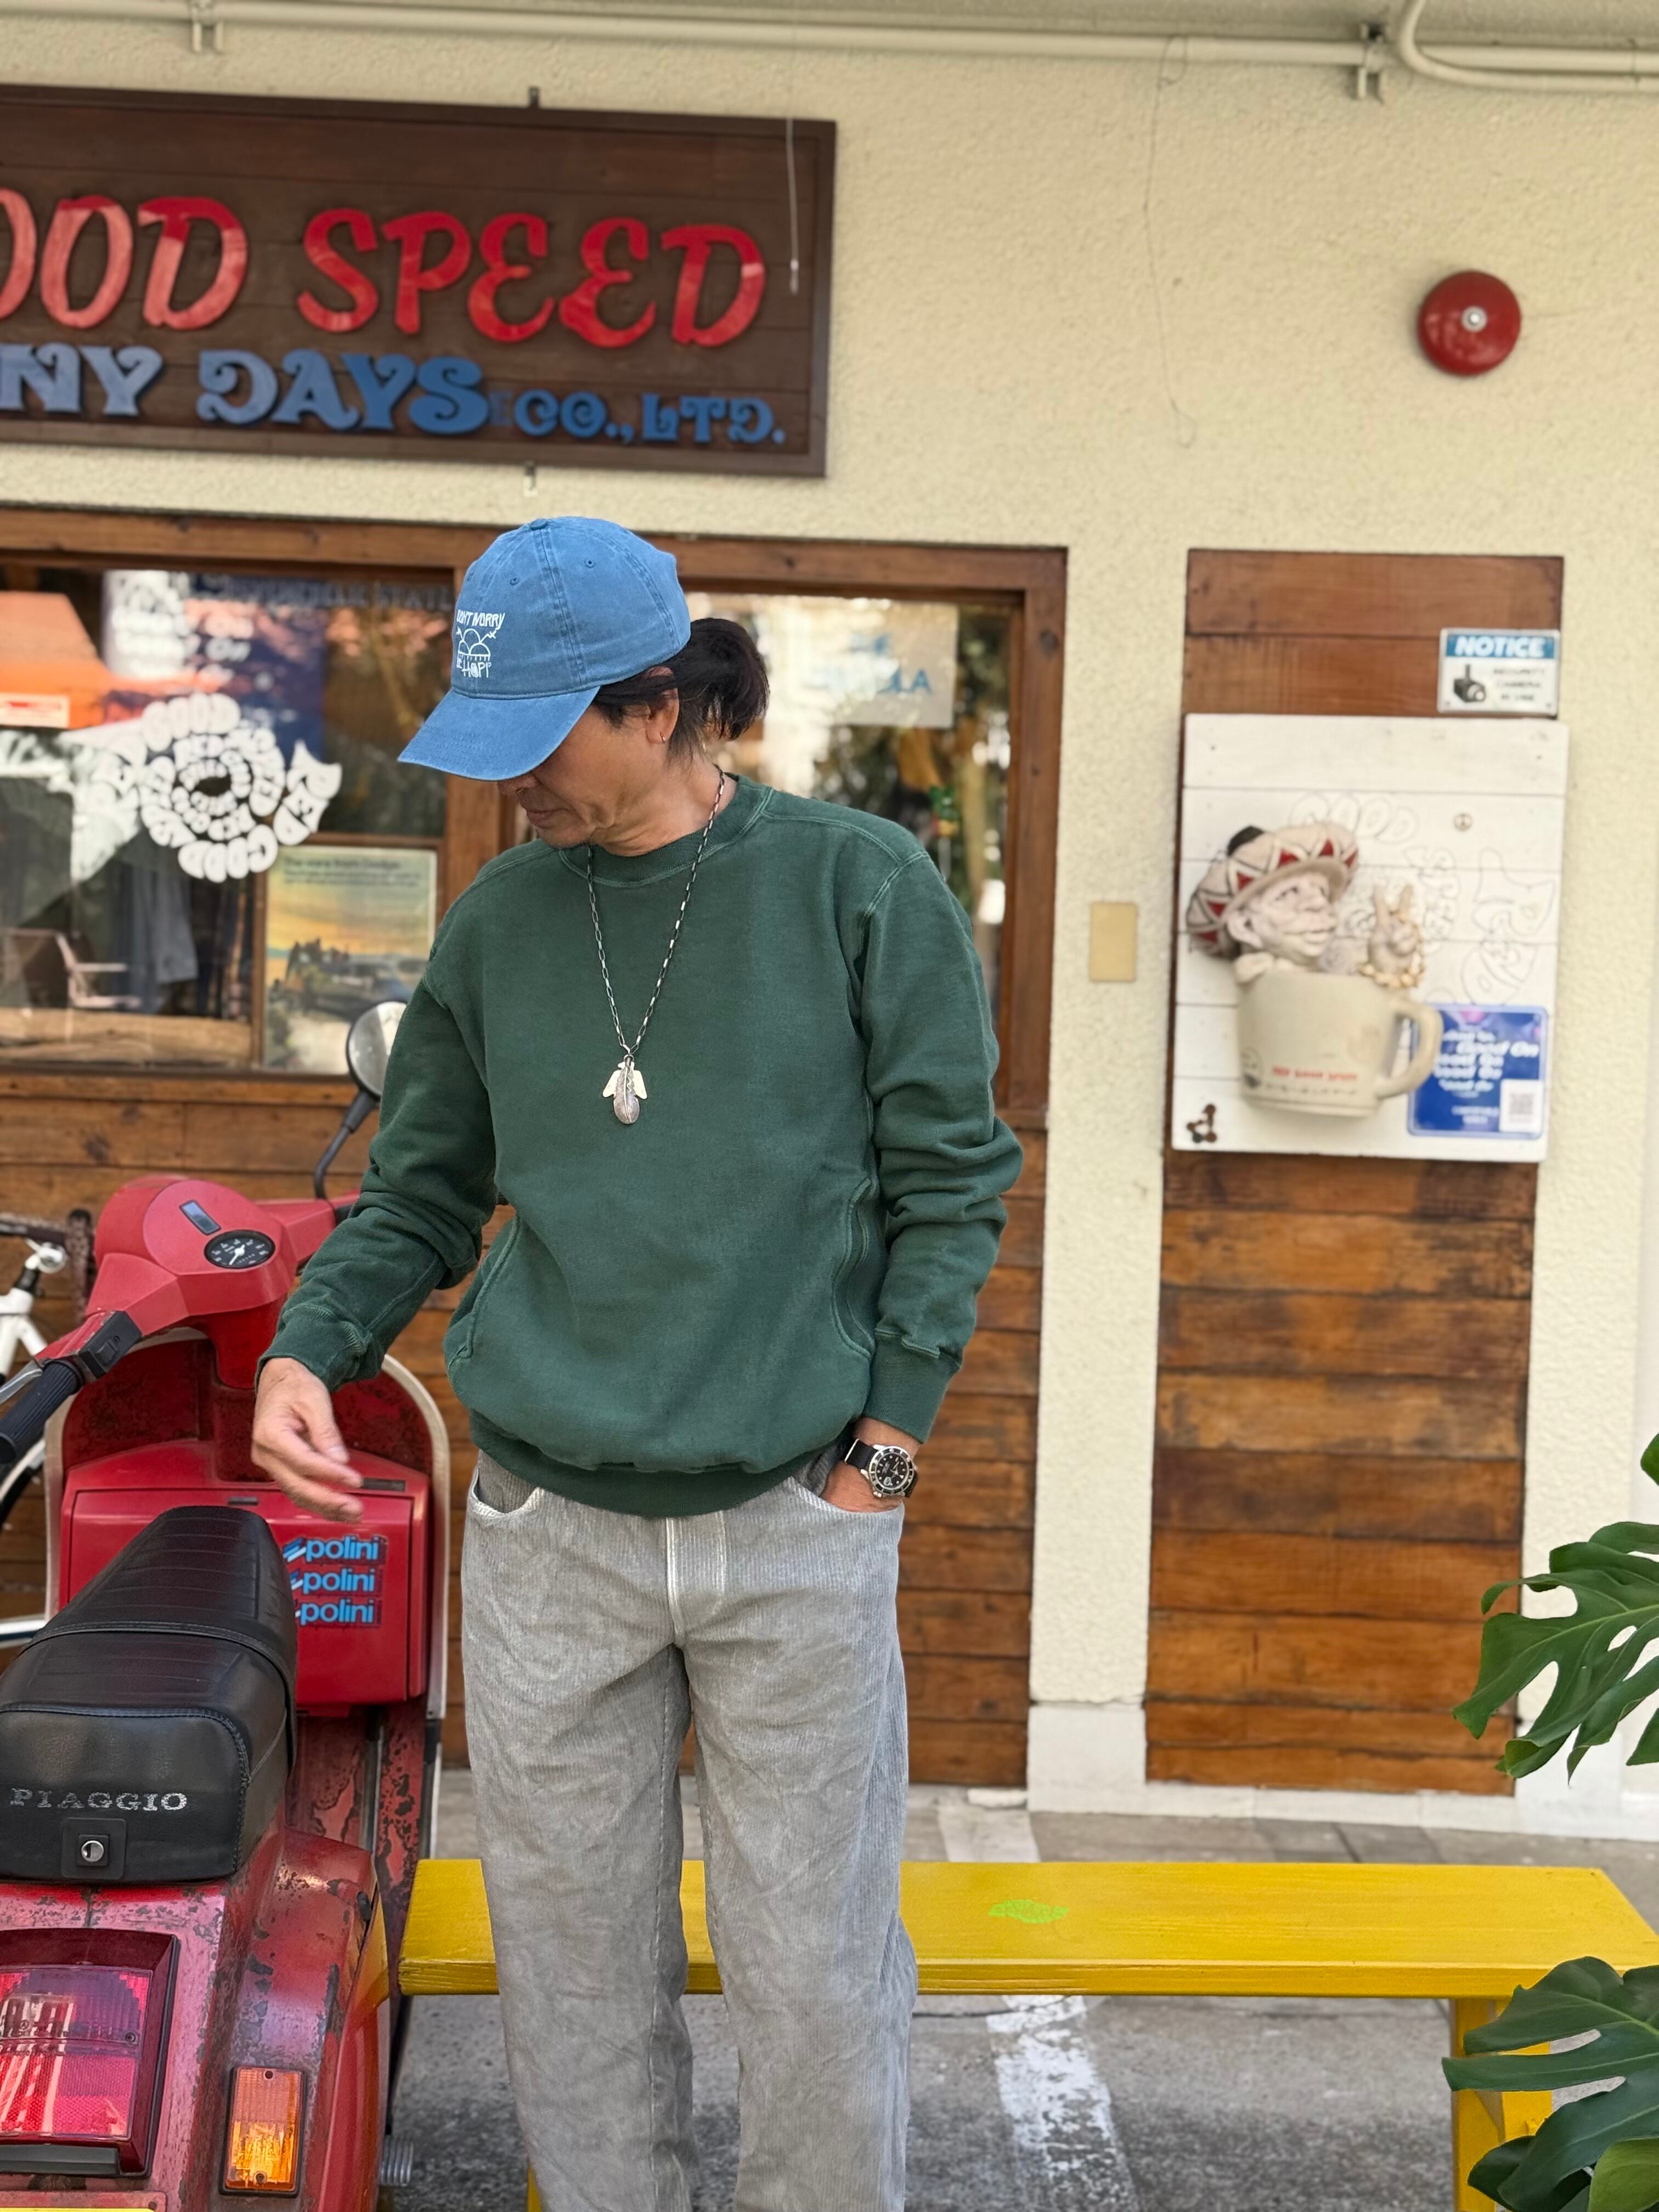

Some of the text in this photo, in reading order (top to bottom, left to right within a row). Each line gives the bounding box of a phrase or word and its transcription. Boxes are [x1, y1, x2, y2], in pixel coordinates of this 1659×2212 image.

[297, 208, 765, 348] SPEED
[196, 348, 489, 435] DAYS
[1455, 636, 1545, 657] NOTICE
[1510, 1041, 1539, 1057] On
[306, 1536, 379, 1562] polini
[303, 1568, 375, 1594] polini
[300, 1598, 374, 1626] polini
[9, 1787, 188, 1811] PIAGGIO
